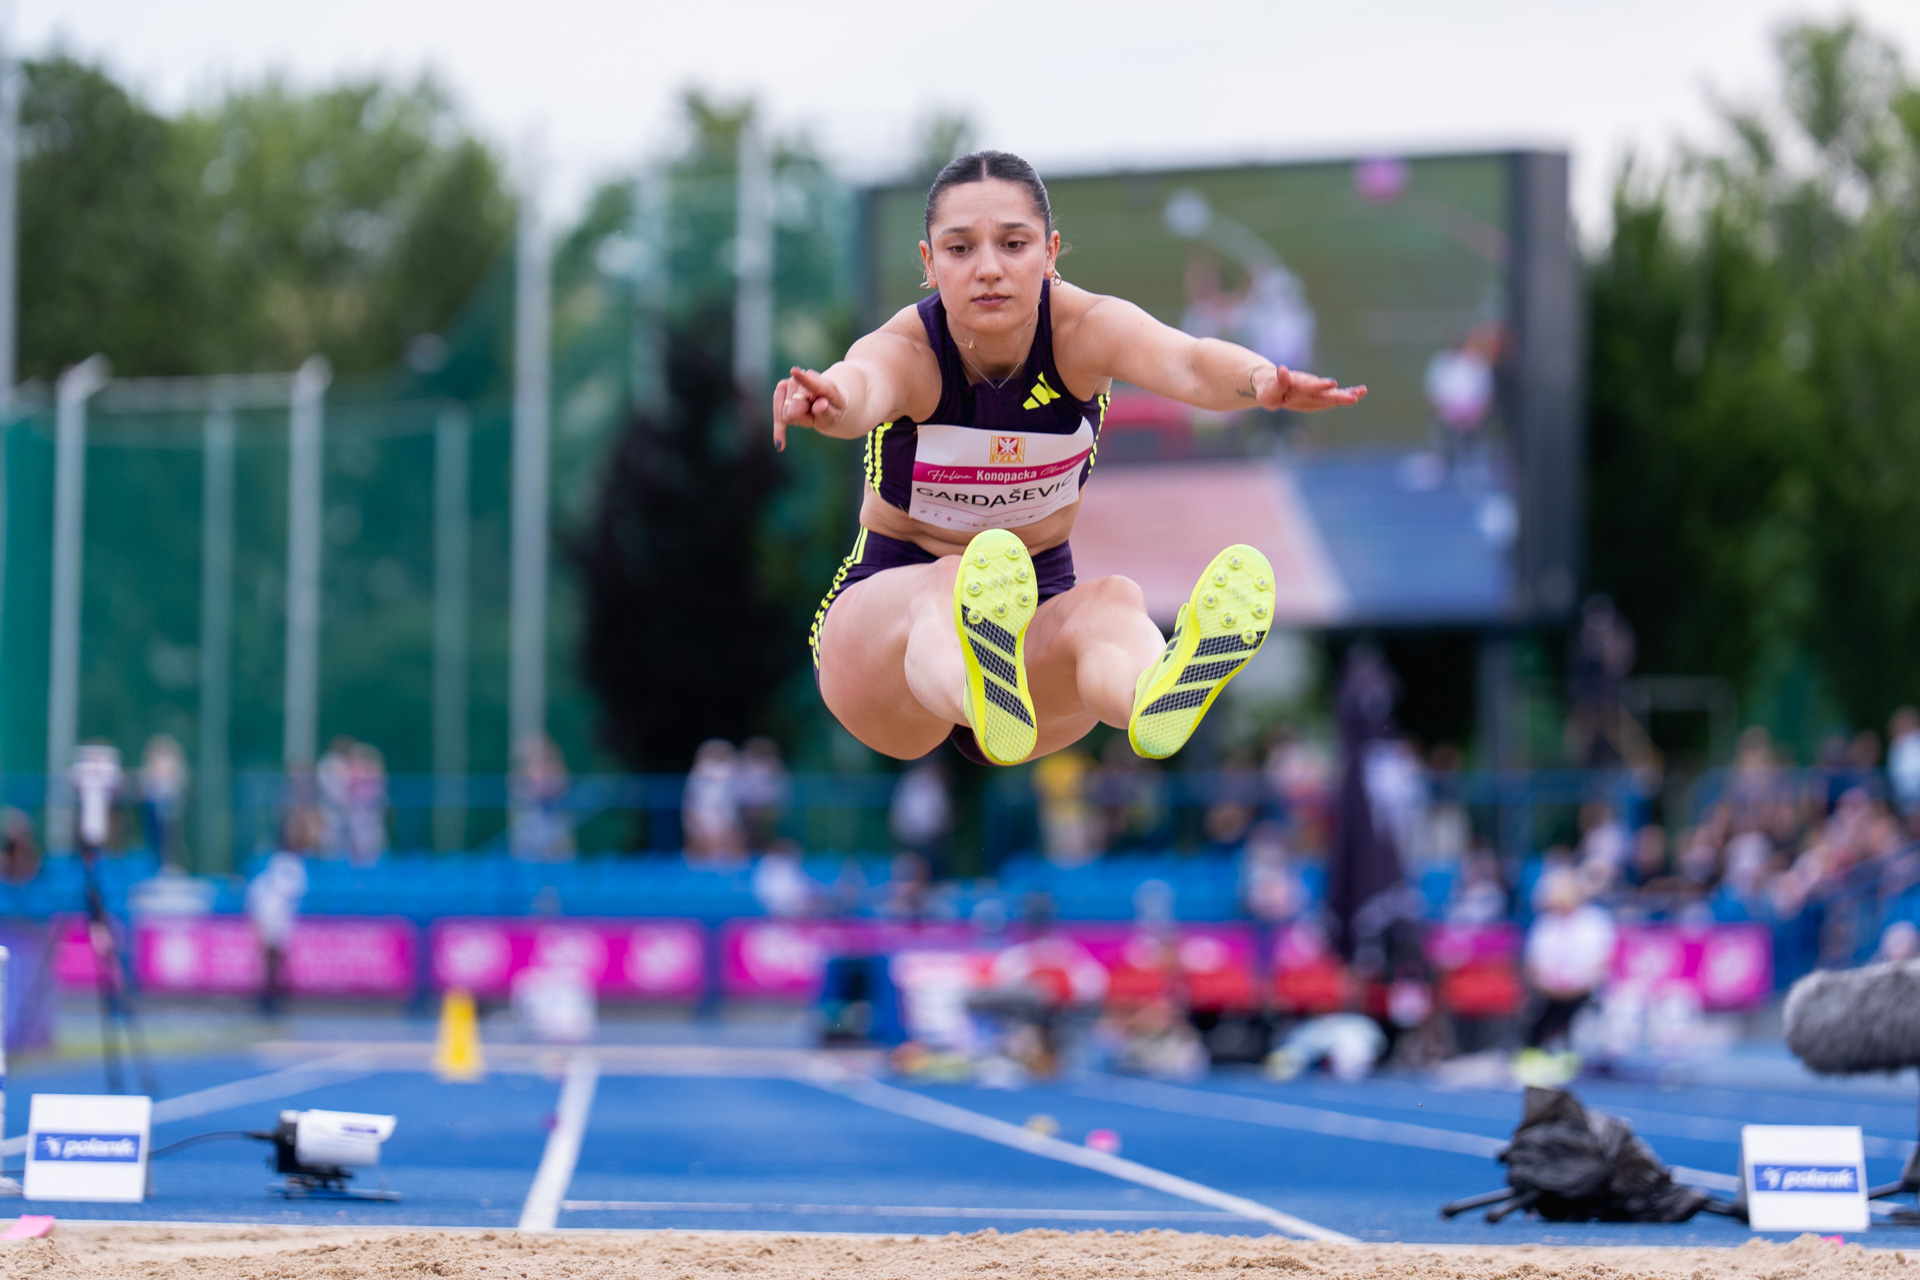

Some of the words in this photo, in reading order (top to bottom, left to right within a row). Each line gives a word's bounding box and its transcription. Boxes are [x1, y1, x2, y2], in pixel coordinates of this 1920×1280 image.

[991, 454, 1022, 463] PZLA
[927, 469, 973, 483] Halina
[976, 469, 1037, 484] Konopacka
